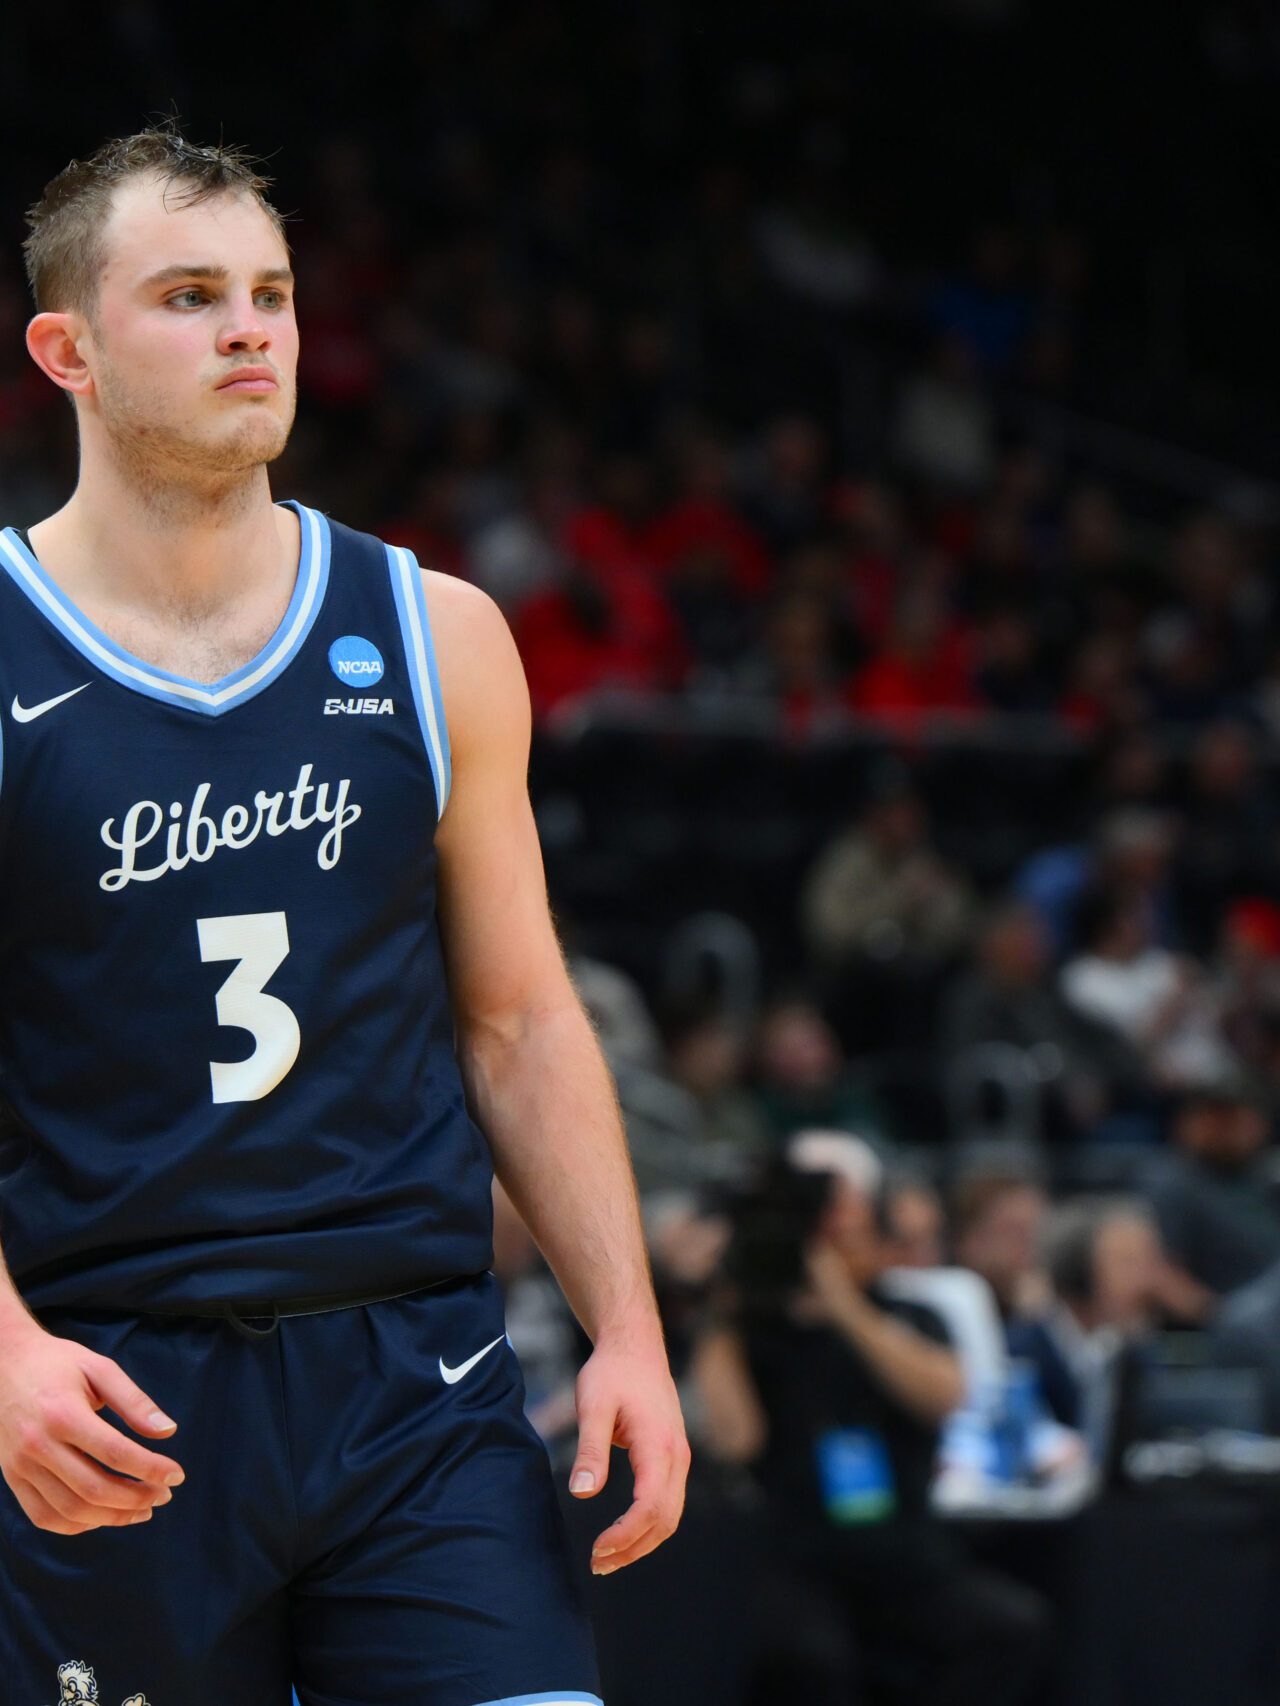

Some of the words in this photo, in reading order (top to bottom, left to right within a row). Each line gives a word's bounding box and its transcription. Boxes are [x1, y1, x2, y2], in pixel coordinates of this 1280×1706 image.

[337, 660, 382, 674] NCAA
[99, 763, 362, 892] Liberty
[196, 911, 301, 1104] 3
